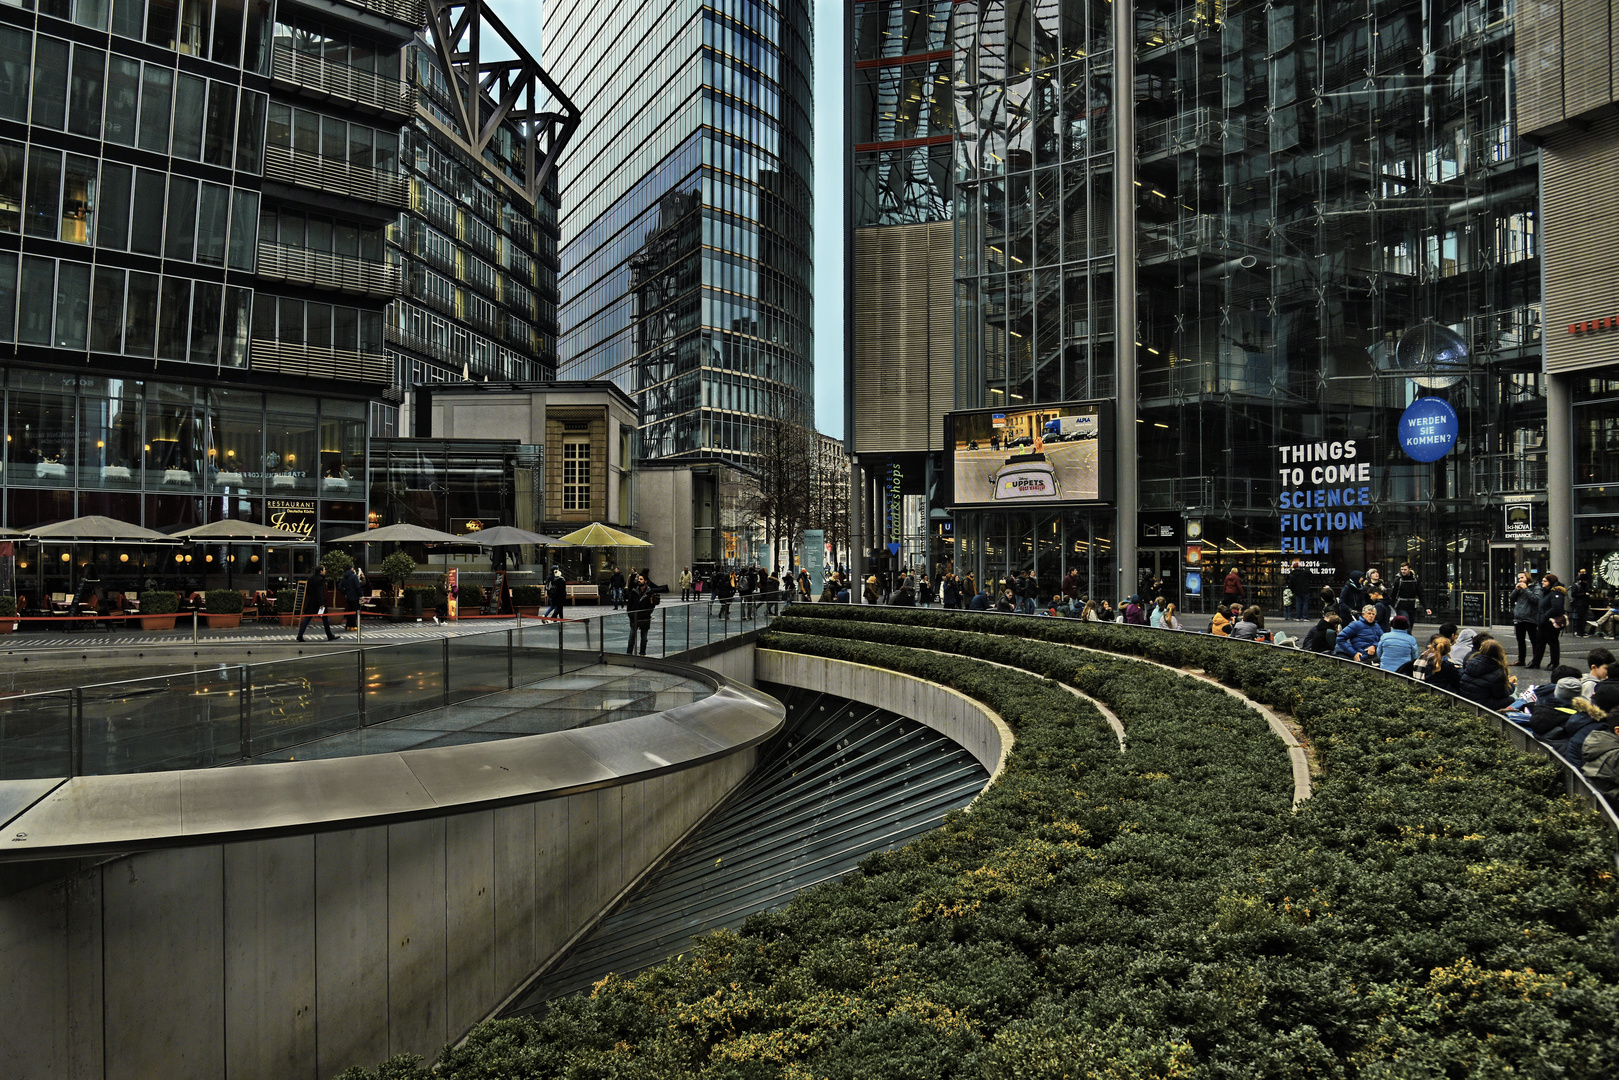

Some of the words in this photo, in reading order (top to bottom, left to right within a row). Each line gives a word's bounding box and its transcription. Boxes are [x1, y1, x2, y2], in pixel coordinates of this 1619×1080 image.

[1408, 415, 1447, 427] WERDEN
[1420, 426, 1435, 435] SIE
[1406, 434, 1451, 446] KOMMEN?
[1279, 440, 1357, 464] THINGS
[1279, 468, 1304, 486] TO
[1311, 463, 1370, 485] COME
[890, 463, 904, 540] food&shops
[1280, 487, 1369, 509] SCIENCE
[271, 511, 315, 541] Josty
[1280, 511, 1363, 531] FICTION
[1280, 536, 1329, 554] FILM
